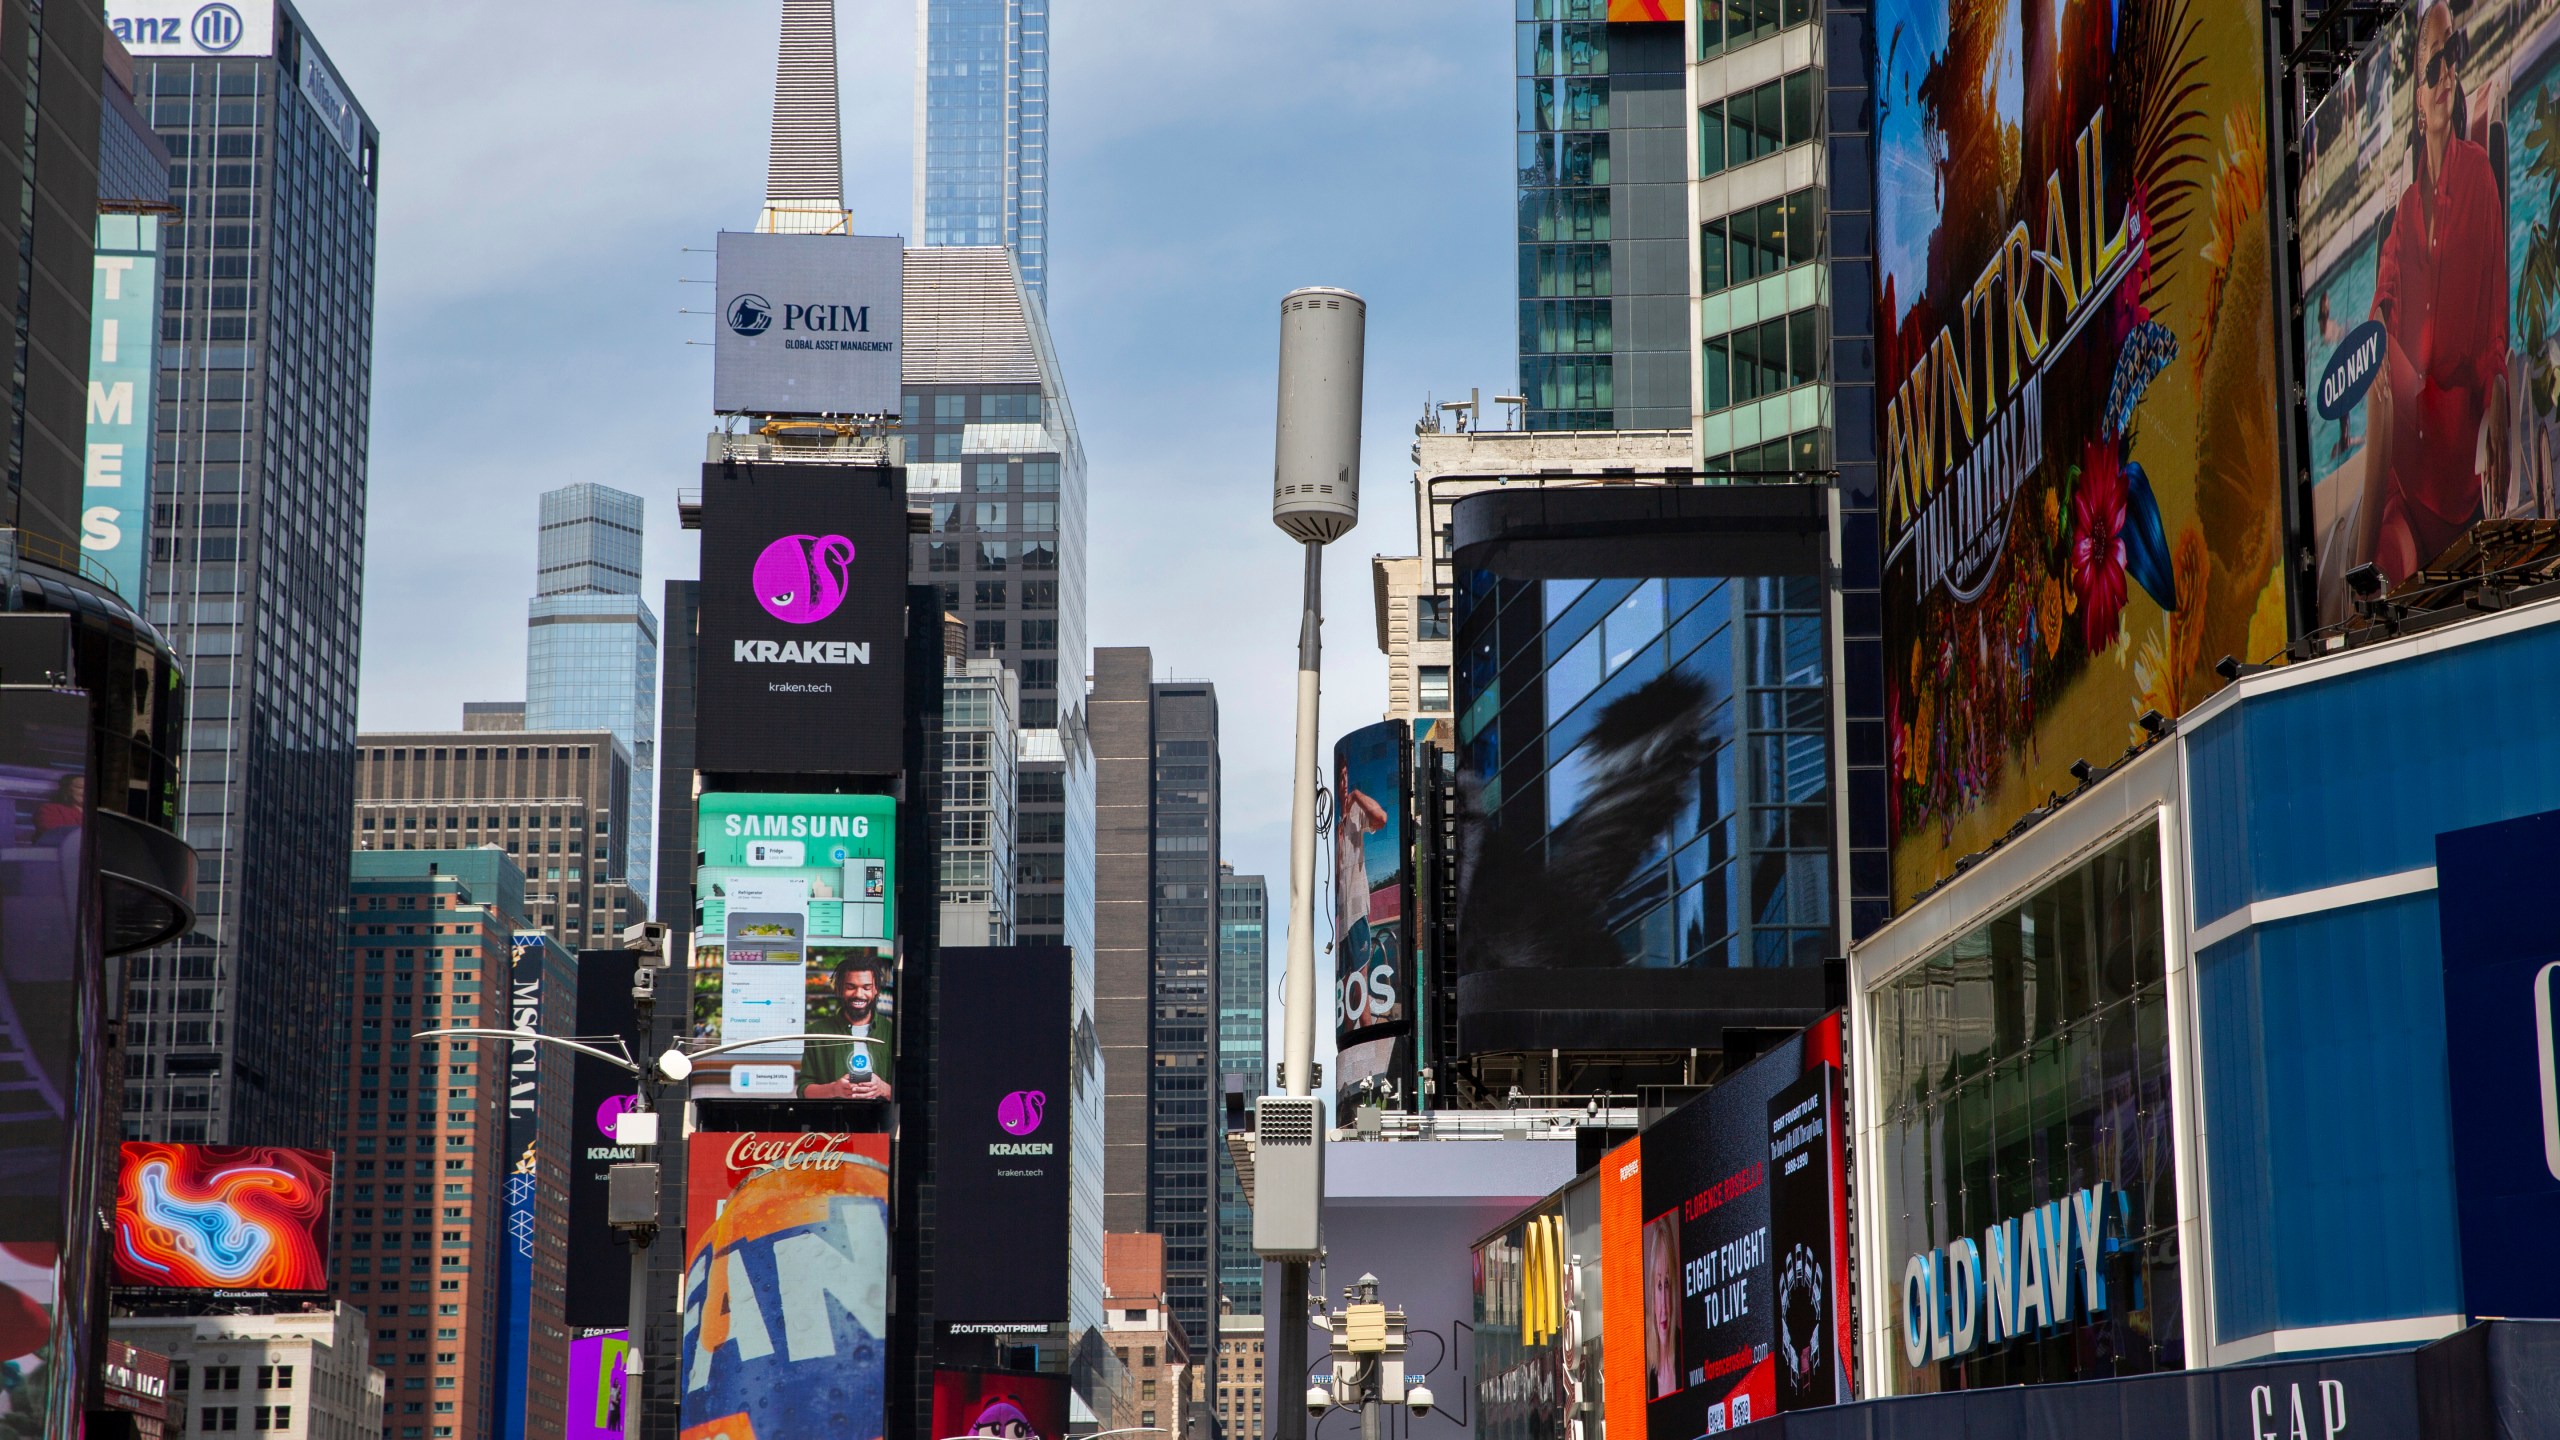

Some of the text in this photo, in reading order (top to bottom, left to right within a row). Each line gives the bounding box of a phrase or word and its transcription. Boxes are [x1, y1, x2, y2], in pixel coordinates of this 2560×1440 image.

[307, 58, 340, 130] Allianz
[783, 304, 870, 332] PGIM
[785, 339, 893, 352] GLOBAL ASSET MANAGEMENT
[2324, 331, 2378, 408] OLD NAVY
[79, 257, 134, 551] TIMES
[1914, 367, 2043, 606] FINAL FANTASY XIV
[1955, 517, 2001, 586] ONLINE
[734, 639, 870, 665] KRAKEN
[769, 682, 832, 693] kraken.tech
[725, 814, 869, 838] SAMSUNG
[989, 1143, 1053, 1155] KRAKEN
[997, 1169, 1044, 1177] kraken.tech
[1685, 1182, 1723, 1224] FLORENCE
[1686, 1227, 1766, 1298] EIGHT FOUGHT
[1903, 1180, 2111, 1368] OLD NAVY
[1705, 1278, 1748, 1330] TO LIVE
[950, 1324, 1048, 1334] #OUTFRONTPRIME
[2250, 1380, 2346, 1440] GAP
